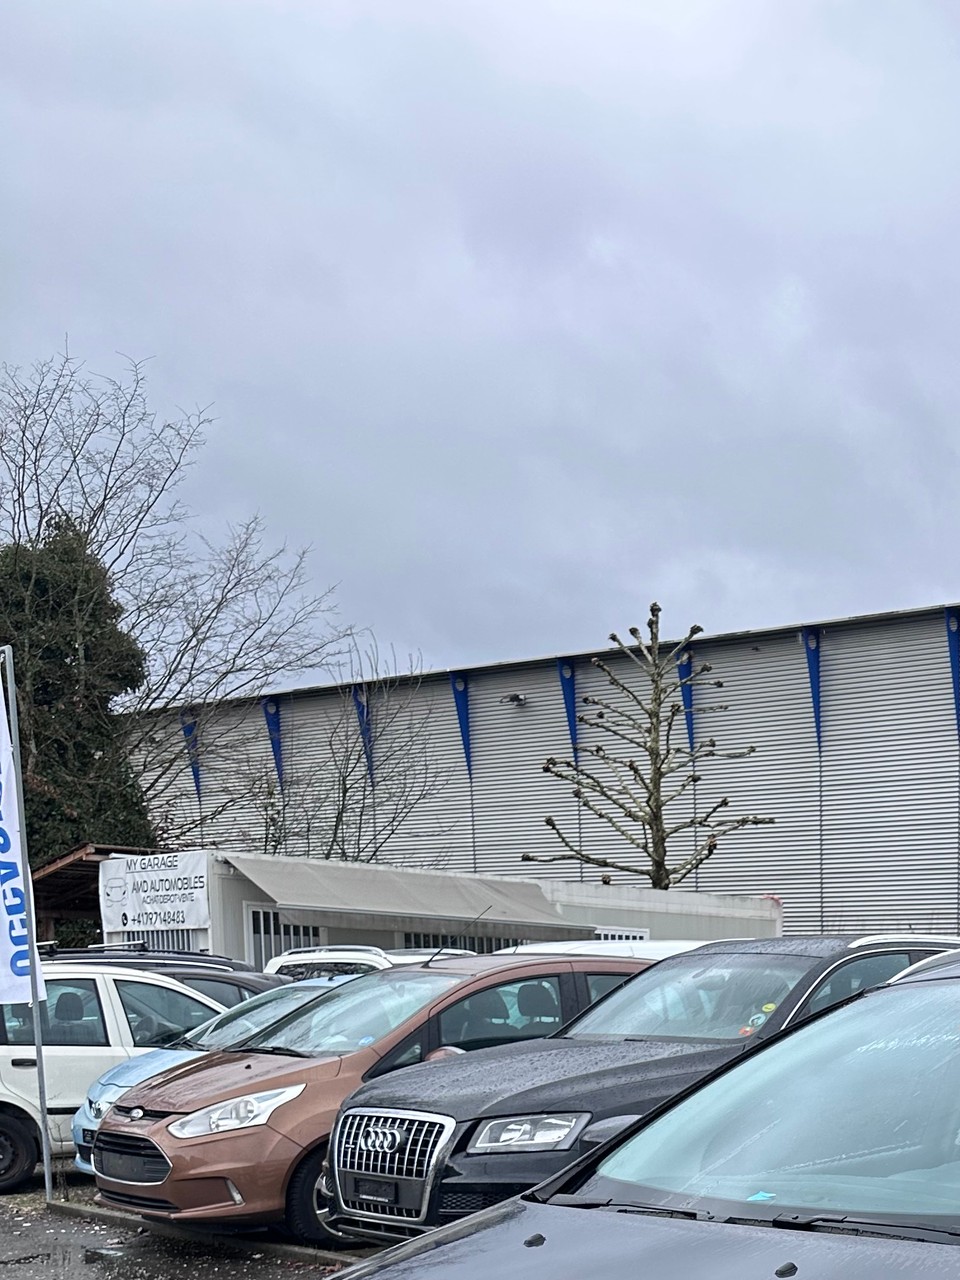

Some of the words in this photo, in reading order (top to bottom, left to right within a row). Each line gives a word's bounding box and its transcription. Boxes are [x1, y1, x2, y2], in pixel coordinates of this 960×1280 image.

[126, 859, 138, 871] MY
[140, 855, 178, 870] GARAGE
[132, 880, 148, 894] AMD
[150, 875, 205, 892] AUTOMOBILES
